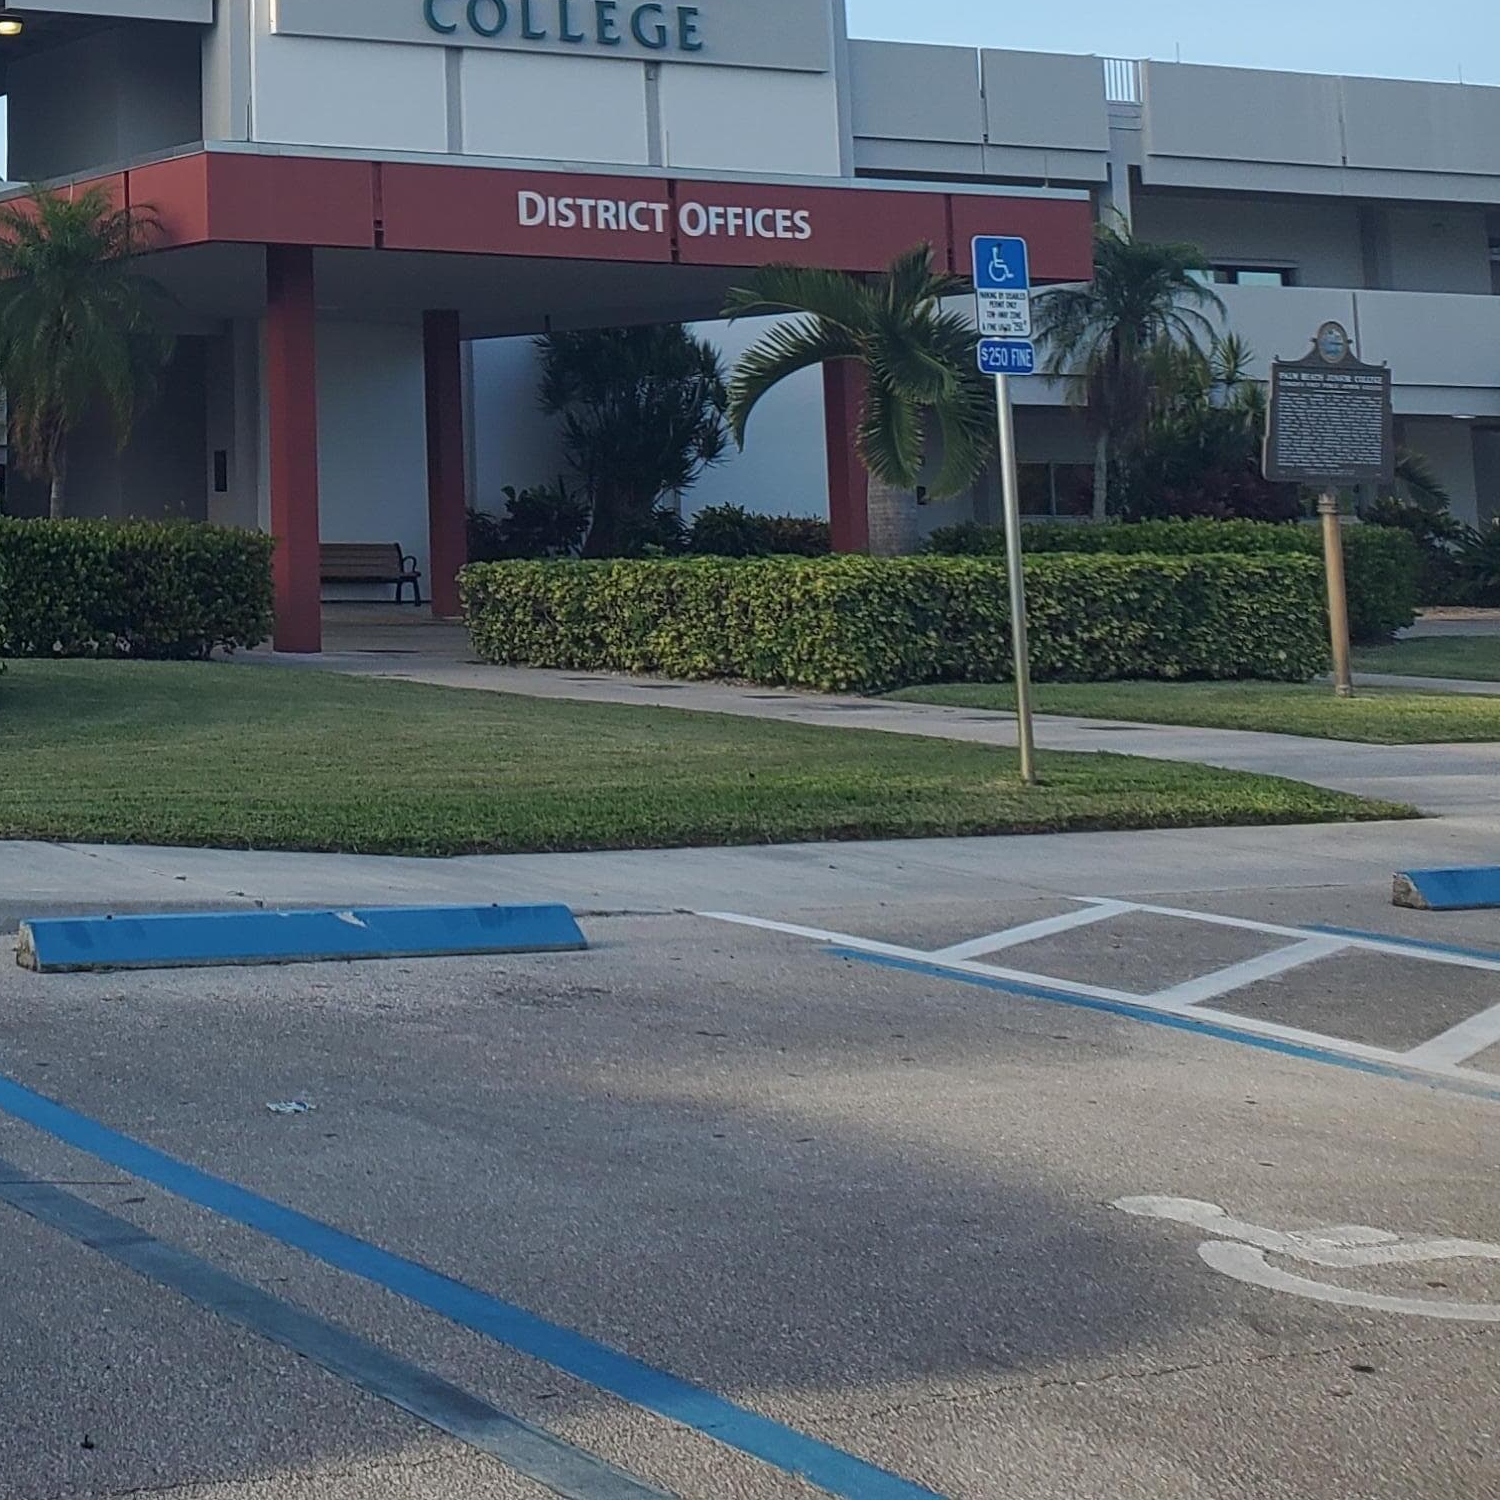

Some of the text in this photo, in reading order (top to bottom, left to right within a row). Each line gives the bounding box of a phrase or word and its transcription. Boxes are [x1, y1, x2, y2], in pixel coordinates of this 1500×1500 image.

[517, 191, 811, 240] DISTRICT OFFICES
[981, 347, 1032, 368] $250 FINE
